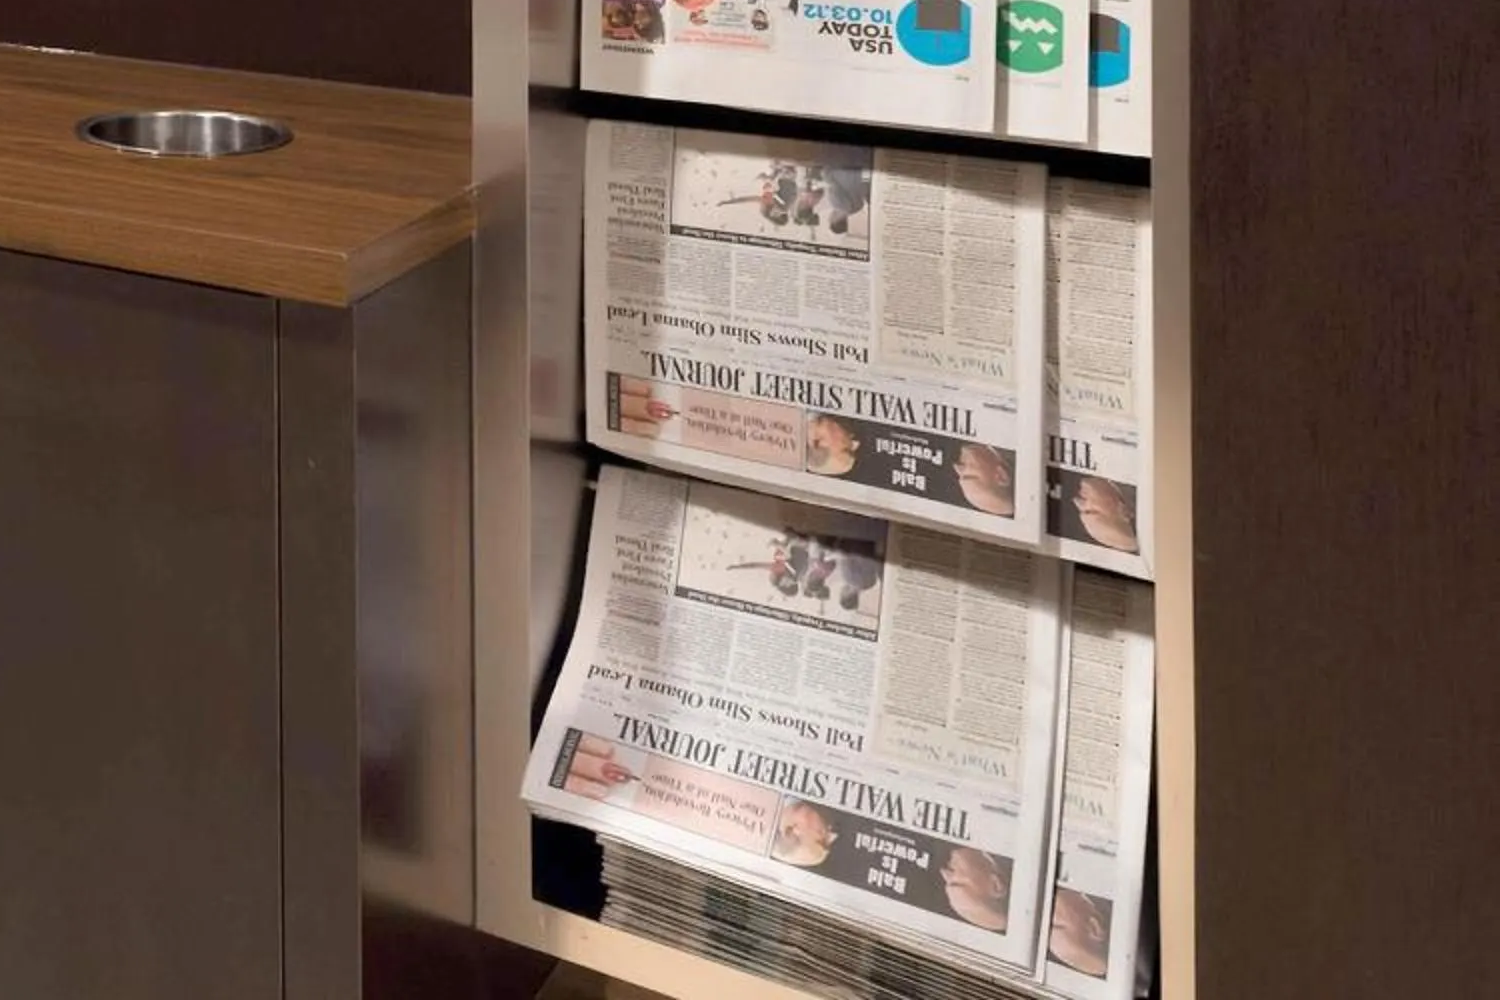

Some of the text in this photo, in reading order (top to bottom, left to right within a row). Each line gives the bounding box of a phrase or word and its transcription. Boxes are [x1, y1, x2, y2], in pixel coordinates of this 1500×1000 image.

[803, 4, 893, 24] 10.03.12
[818, 20, 892, 38] TODAY
[849, 38, 893, 55] USA
[606, 305, 870, 364] Poll Shows Slim Obama Lead
[750, 370, 844, 410] STREET
[849, 386, 916, 426] WALL
[922, 402, 976, 438] THE
[876, 438, 943, 466] Powerful
[902, 458, 916, 472] Is
[892, 470, 926, 492] Bald
[587, 663, 864, 752] Poll Shows Slim Obama Lead
[727, 748, 829, 798] STREET
[834, 776, 904, 823] WALL
[914, 798, 970, 841] THE
[855, 832, 930, 868] Powerful
[882, 855, 896, 870] Is
[868, 868, 906, 894] Bald
